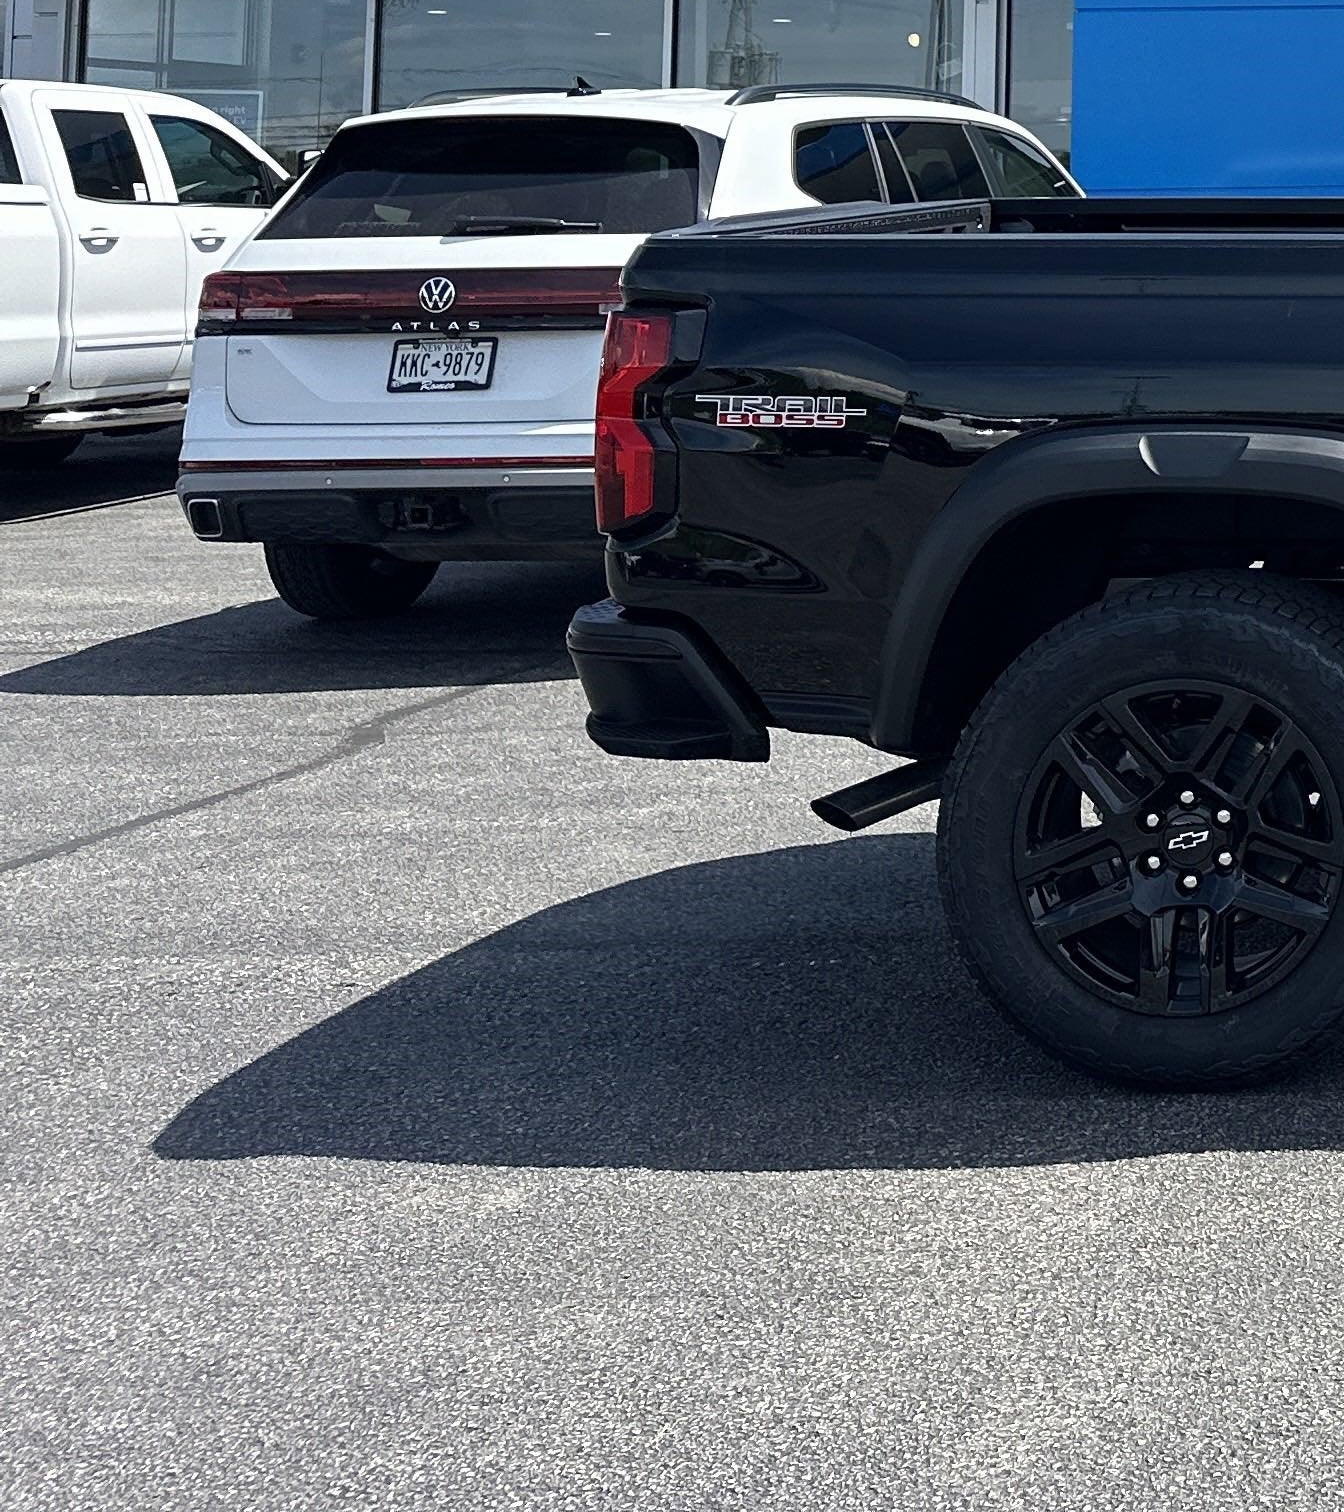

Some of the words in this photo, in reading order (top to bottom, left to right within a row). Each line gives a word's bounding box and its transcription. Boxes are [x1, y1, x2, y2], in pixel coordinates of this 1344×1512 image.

[391, 321, 480, 331] ATLAS
[420, 343, 441, 353] NEW
[445, 342, 470, 352] YORK
[695, 394, 867, 416] TRAIL
[717, 412, 845, 428] BOSS
